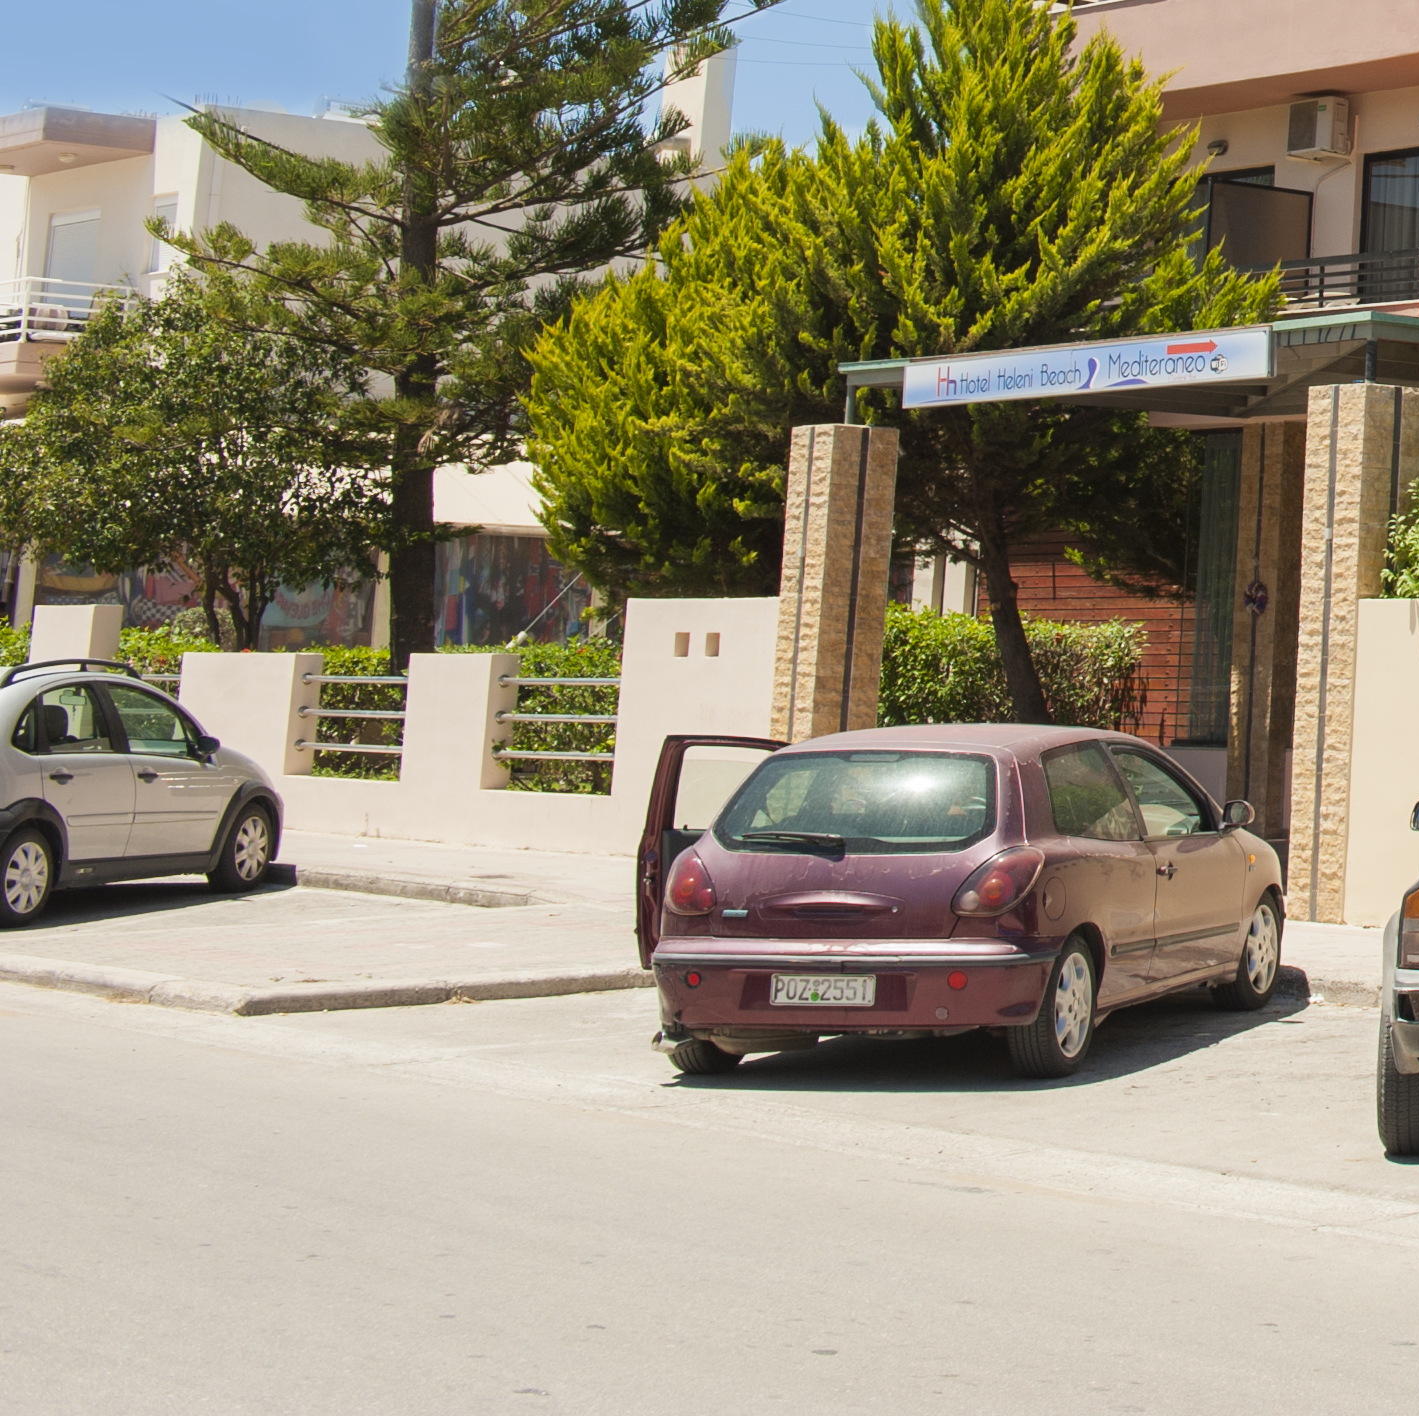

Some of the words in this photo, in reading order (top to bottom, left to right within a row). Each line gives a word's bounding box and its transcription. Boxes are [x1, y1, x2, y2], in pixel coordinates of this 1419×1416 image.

[960, 369, 991, 395] Hotel
[997, 366, 1034, 391] Heleni
[1040, 360, 1082, 387] Beach
[1108, 350, 1206, 379] Mediteraneo
